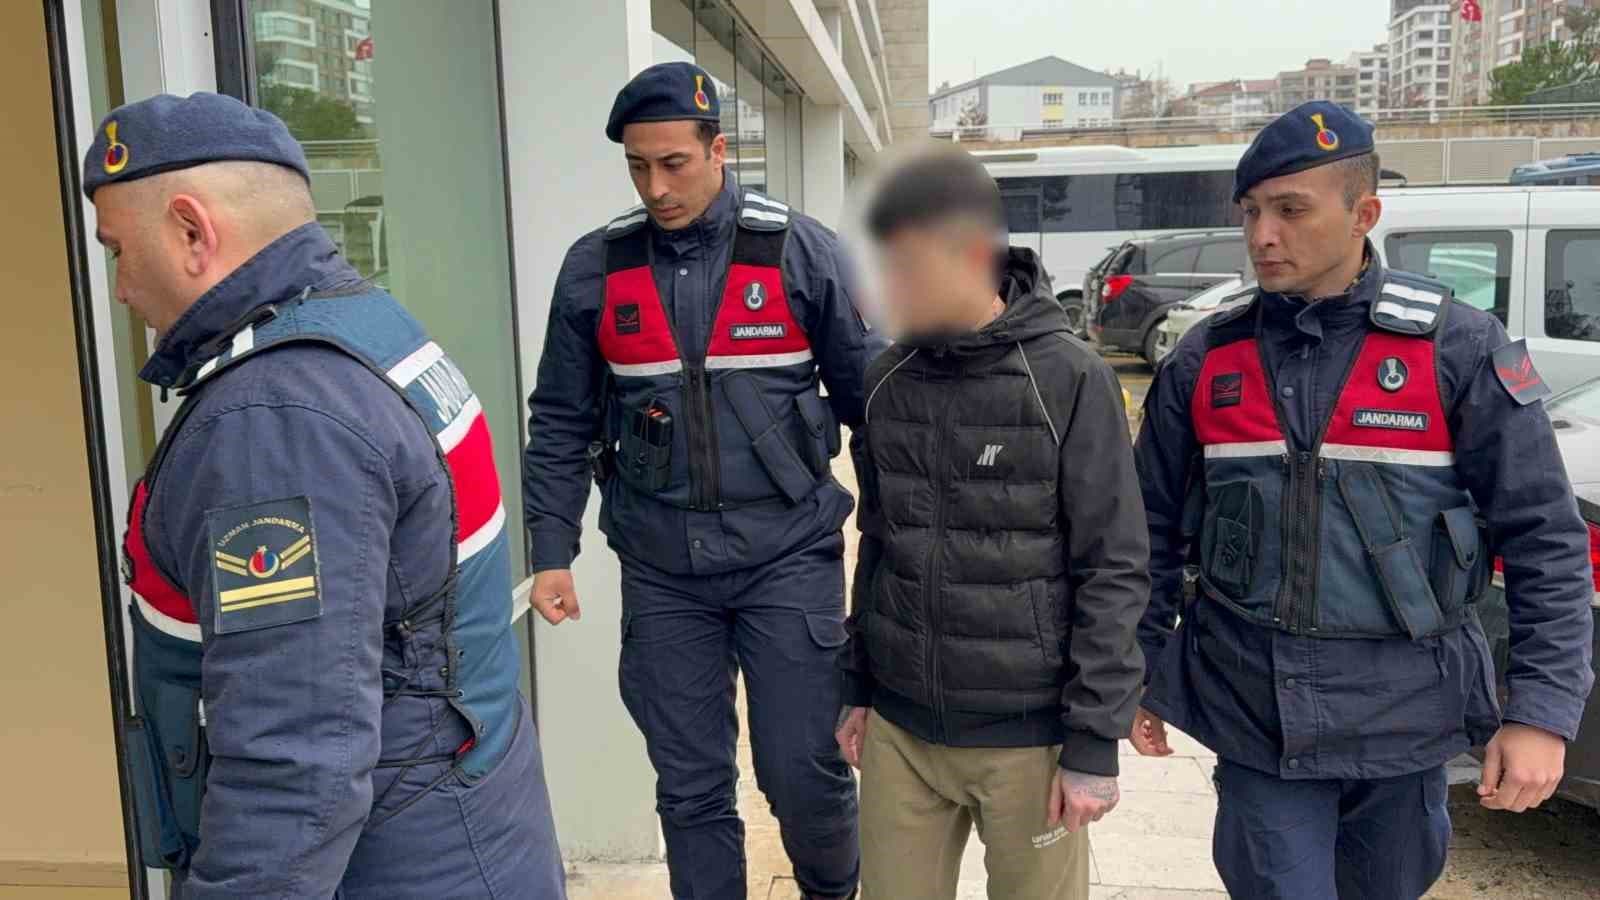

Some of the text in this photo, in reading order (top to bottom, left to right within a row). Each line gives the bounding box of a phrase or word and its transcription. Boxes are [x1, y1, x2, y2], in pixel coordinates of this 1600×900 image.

[734, 325, 783, 336] JANDARMA
[1358, 411, 1424, 427] JANDARMA
[217, 517, 304, 546] UZMAN JANDARMA
